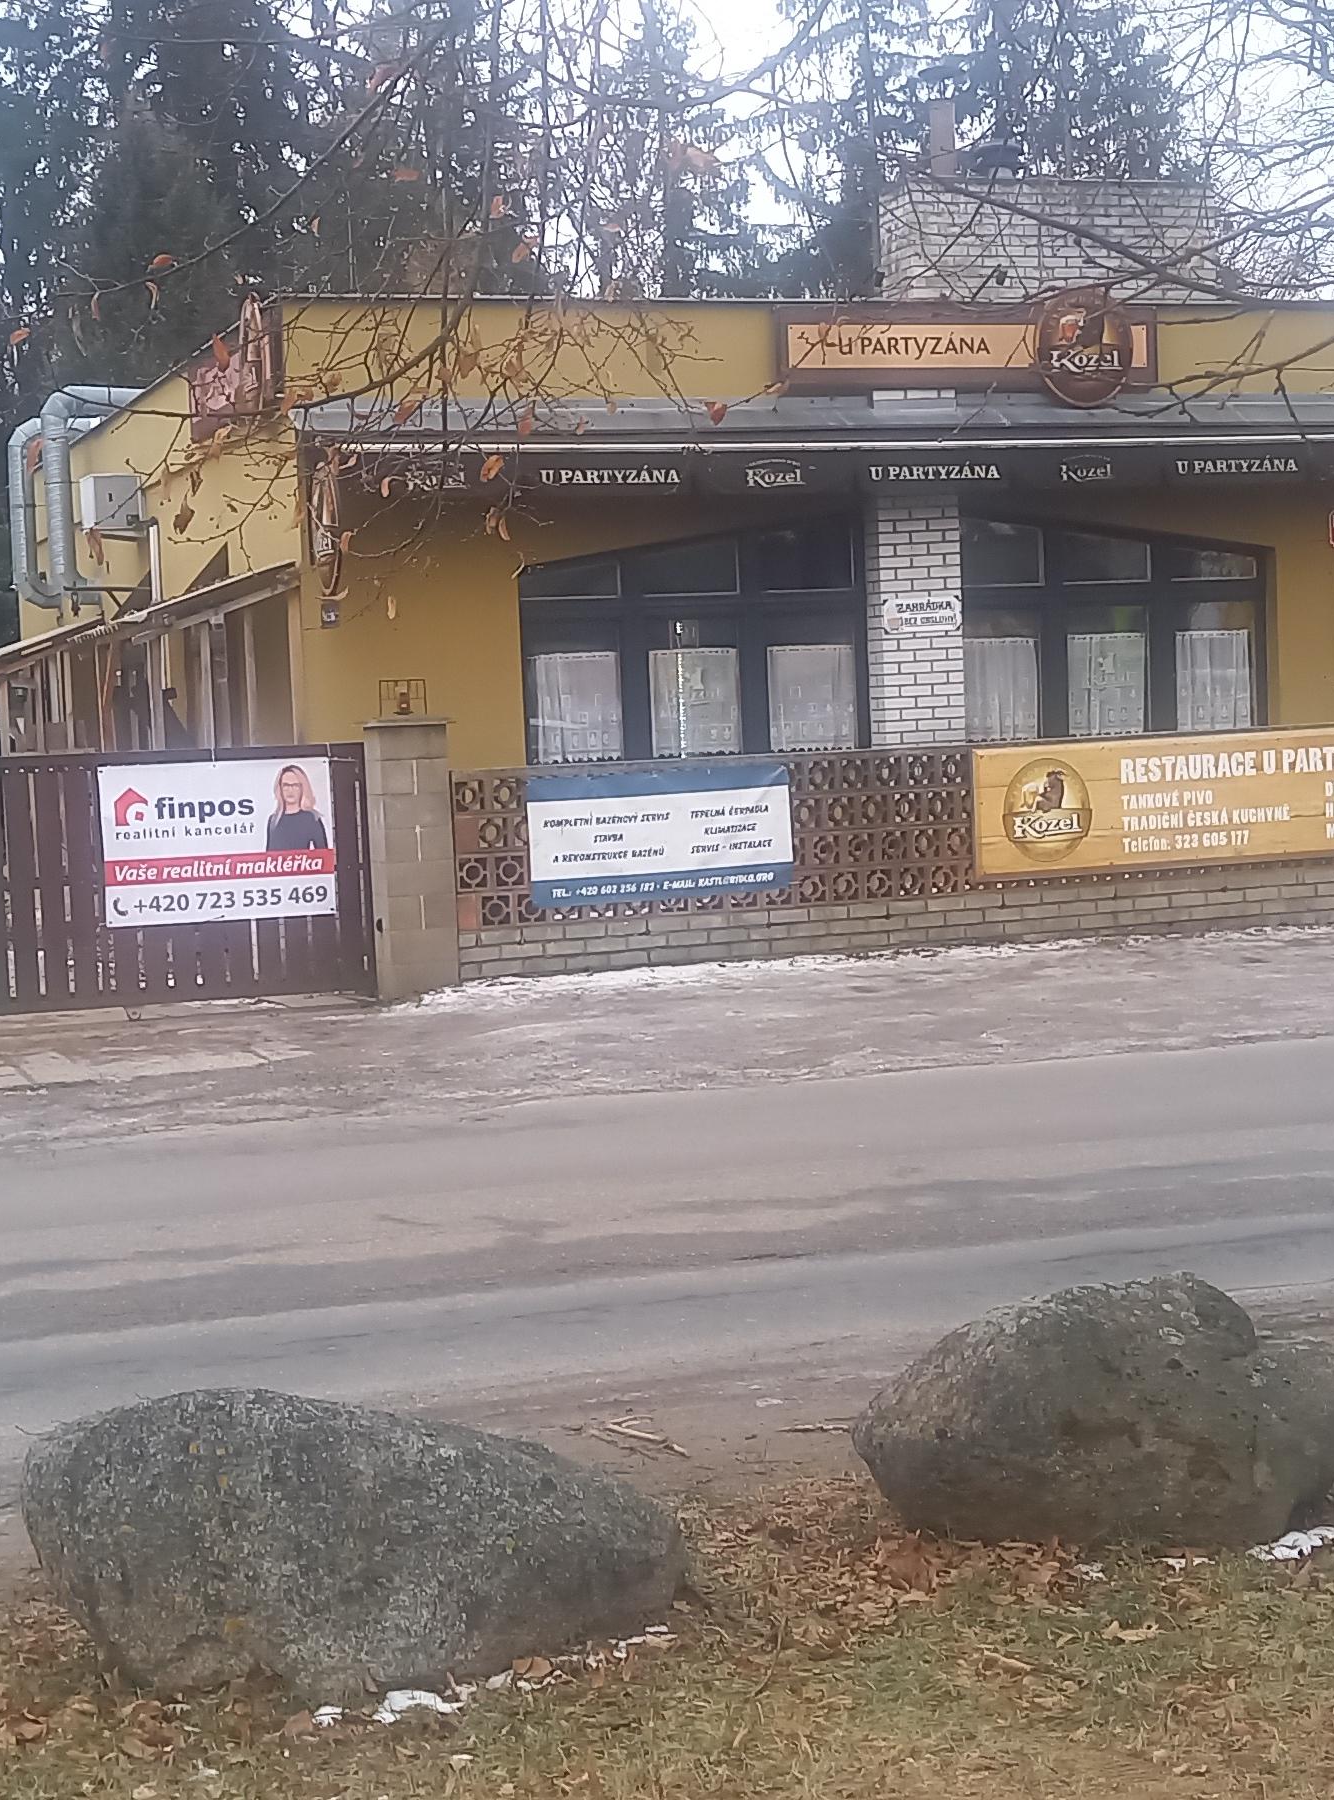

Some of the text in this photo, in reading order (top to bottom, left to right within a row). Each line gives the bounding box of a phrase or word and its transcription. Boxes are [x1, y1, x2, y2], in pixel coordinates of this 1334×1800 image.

[839, 331, 990, 361] U PARTYZÁNA
[1050, 349, 1123, 373] Kozel
[539, 464, 681, 484] U PARTYZÁNA
[869, 460, 1000, 480] U PARTYZÁNA
[1060, 463, 1114, 482] Kozel
[1175, 454, 1298, 475] U PARTYZÁNA
[404, 471, 468, 491] Koel
[745, 468, 805, 487] Kozel
[1120, 751, 1257, 784] RESTAURACE
[1262, 749, 1276, 775] U
[153, 796, 255, 824] finpos
[1121, 789, 1213, 810] TANKOVÉ PIVO
[640, 811, 670, 822] SERVIS
[1012, 813, 1083, 839] Kozel
[1121, 803, 1291, 831] TRADIČNÍ ČESKÁ KUCHYNĚ
[115, 821, 256, 841] realitní kancelář
[593, 833, 624, 843] STAVBA
[1122, 829, 1250, 853] Telefon: 323 605 177
[552, 855, 559, 863] A
[691, 843, 720, 854] SERVIS
[114, 853, 323, 882] Vaše realitní makléřka
[133, 885, 328, 914] +420 723 535 469
